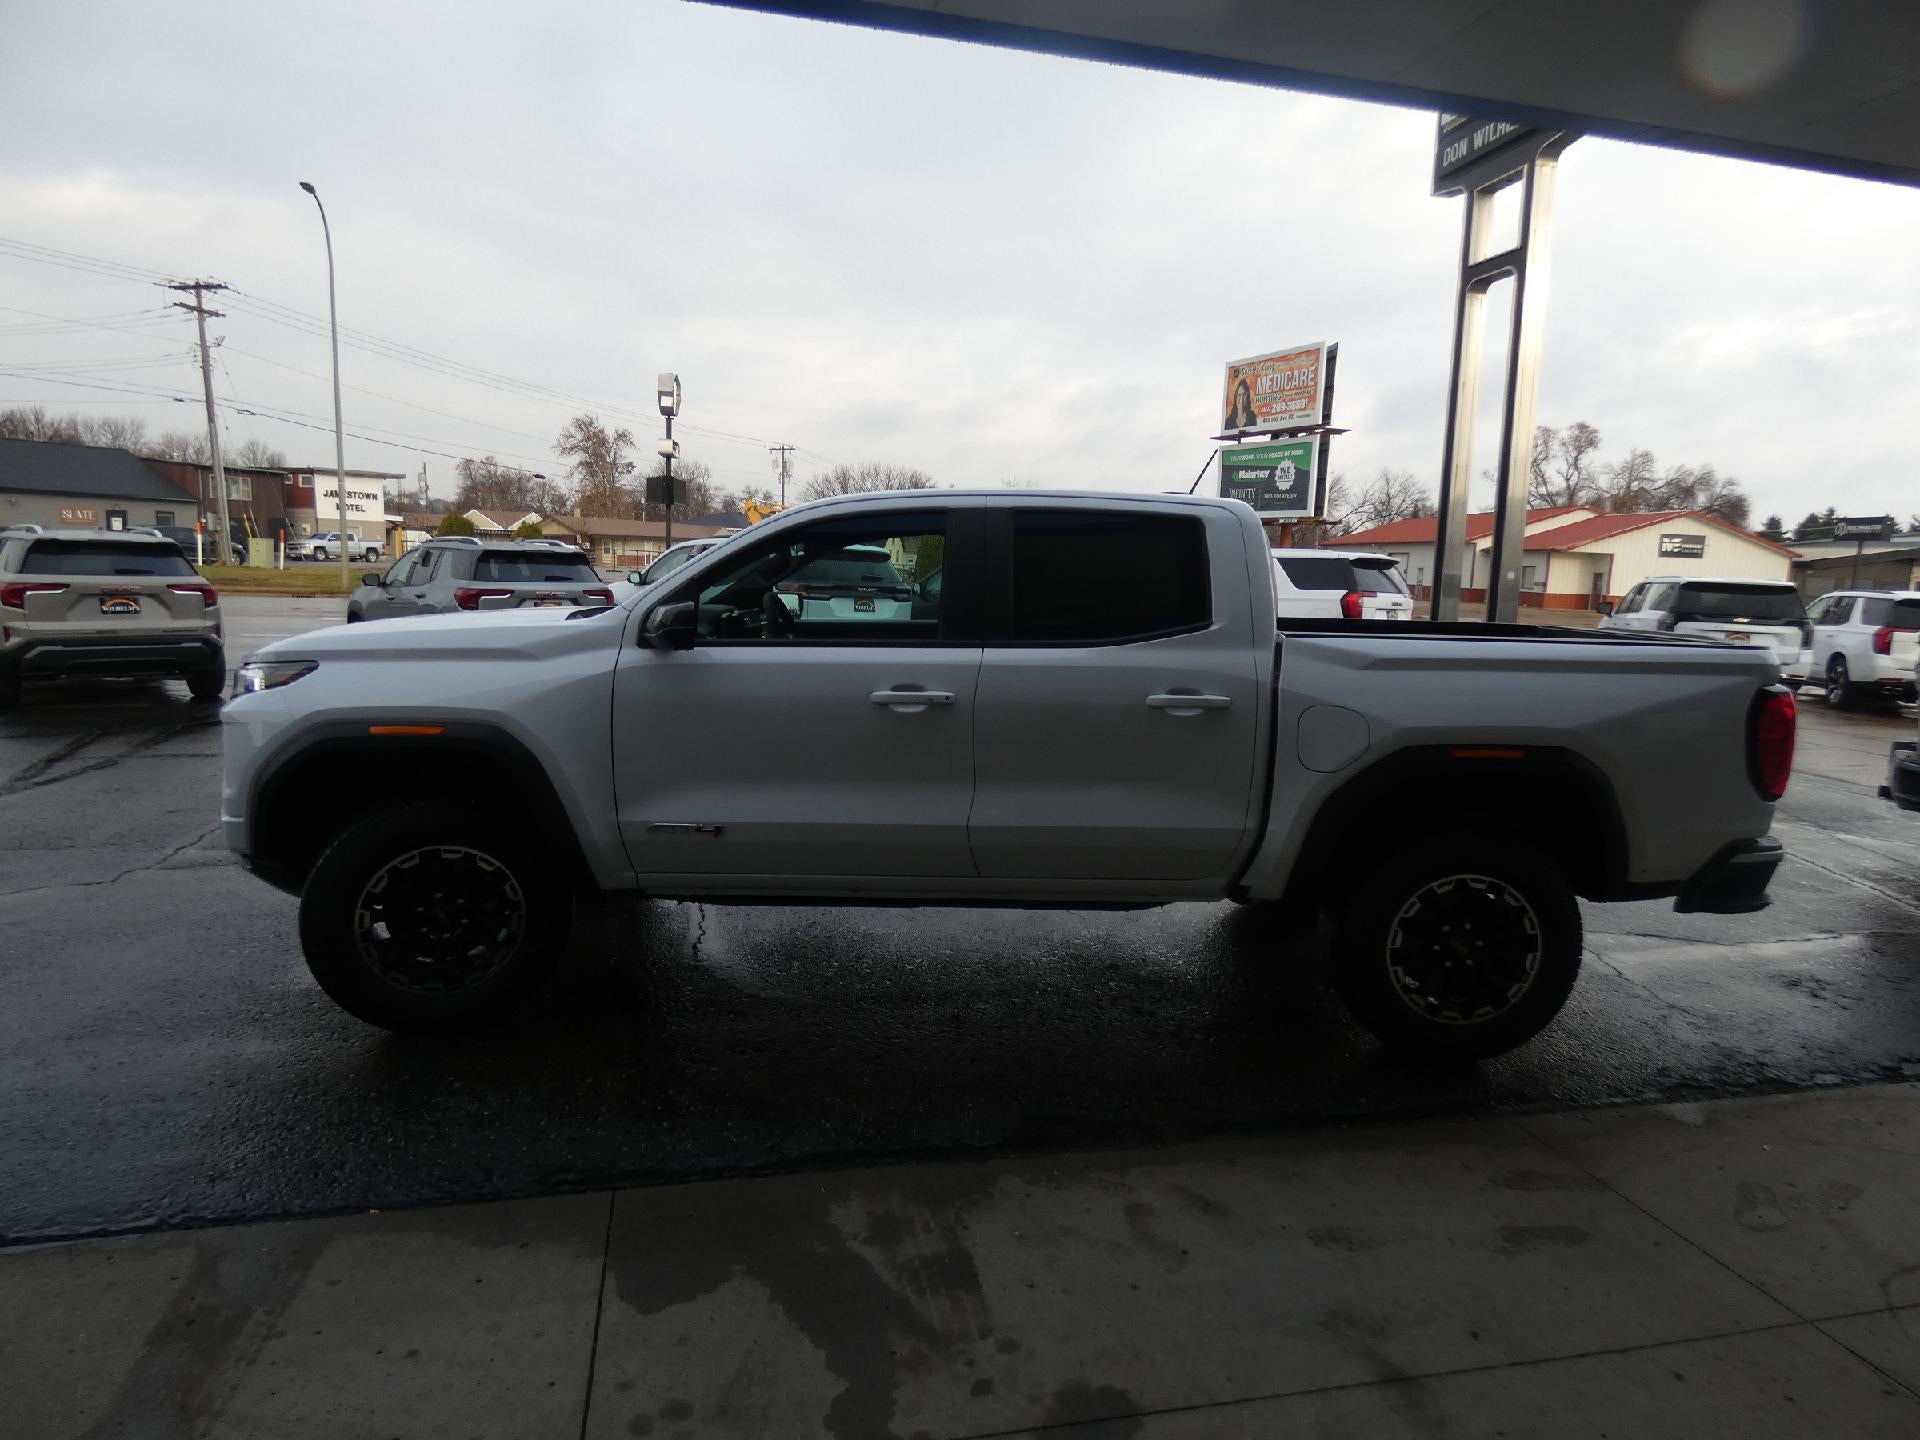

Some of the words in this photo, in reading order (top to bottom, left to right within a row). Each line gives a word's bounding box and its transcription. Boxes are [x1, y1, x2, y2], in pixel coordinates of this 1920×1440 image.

[1442, 137, 1468, 167] DON
[1256, 366, 1316, 394] MEDICARE
[61, 507, 96, 520] SLATE
